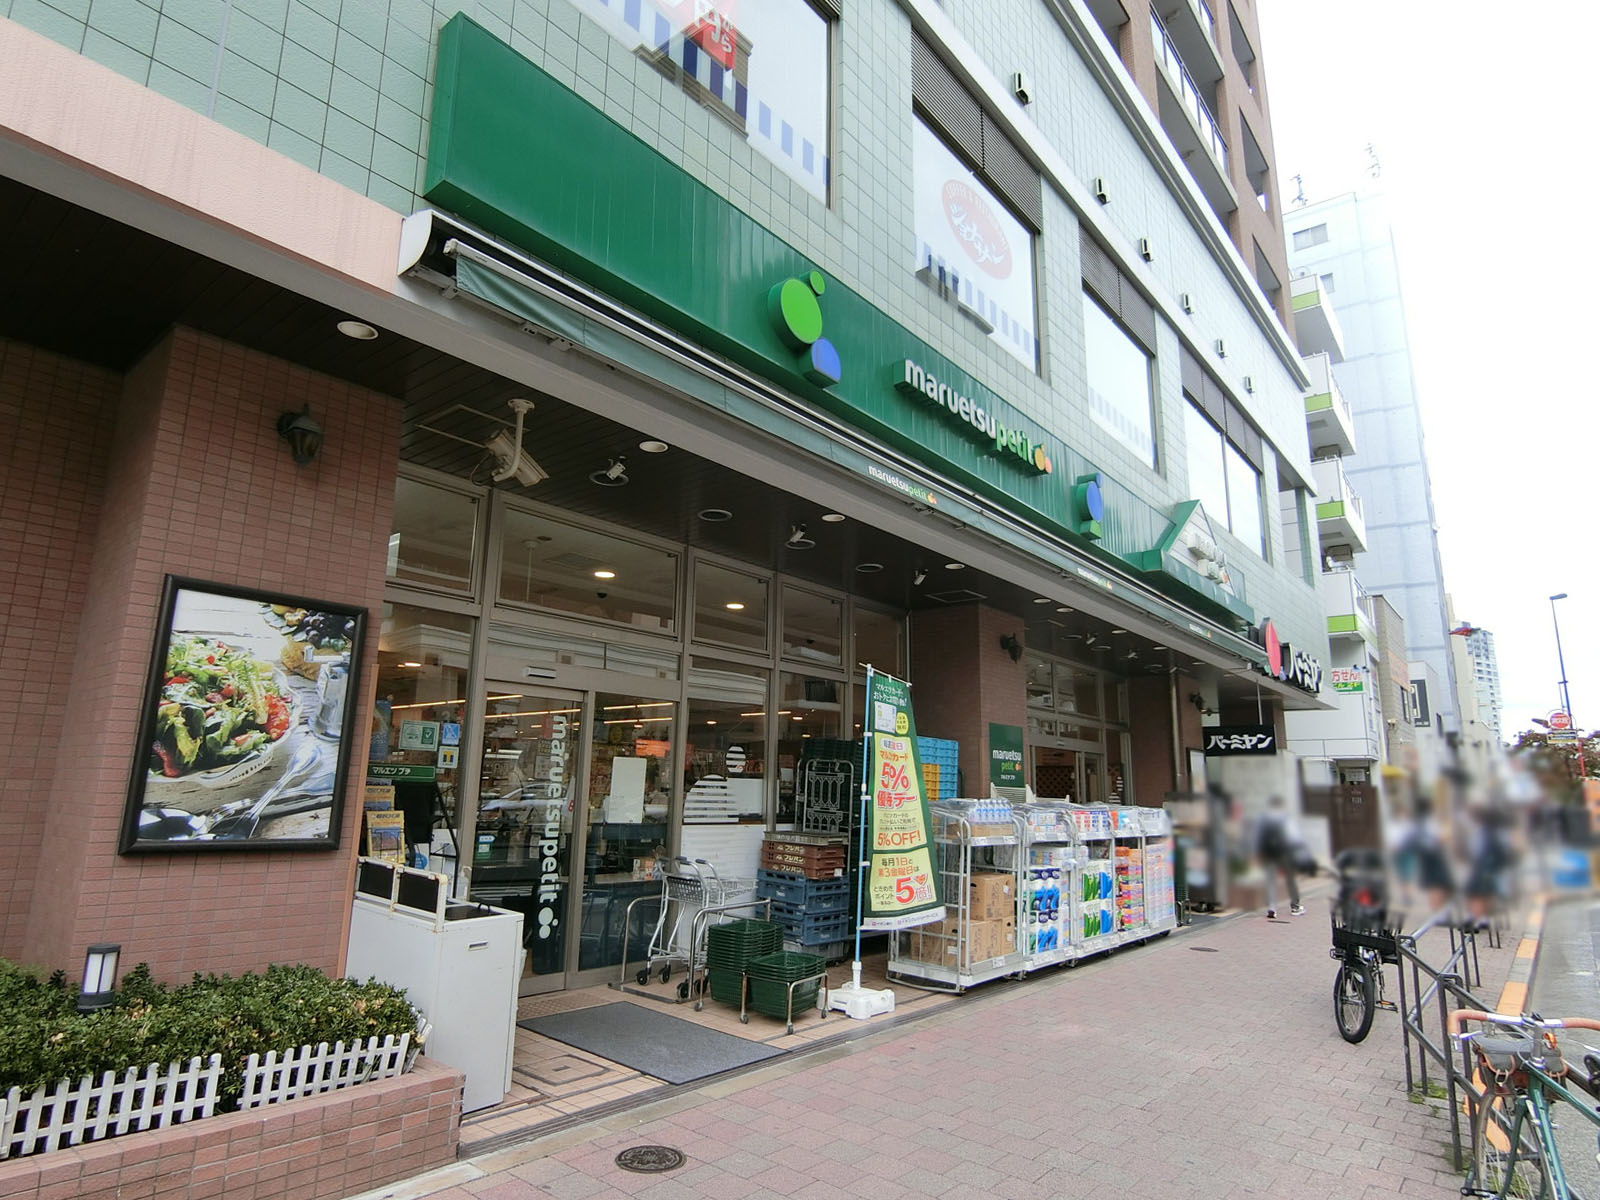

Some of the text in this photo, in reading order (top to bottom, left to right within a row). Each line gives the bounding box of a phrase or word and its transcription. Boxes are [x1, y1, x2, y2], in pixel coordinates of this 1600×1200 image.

[1206, 733, 1273, 750] バーミヤン
[993, 750, 1022, 761] maruetsu
[881, 763, 909, 790] 5%
[881, 857, 913, 867] 毎月1日と
